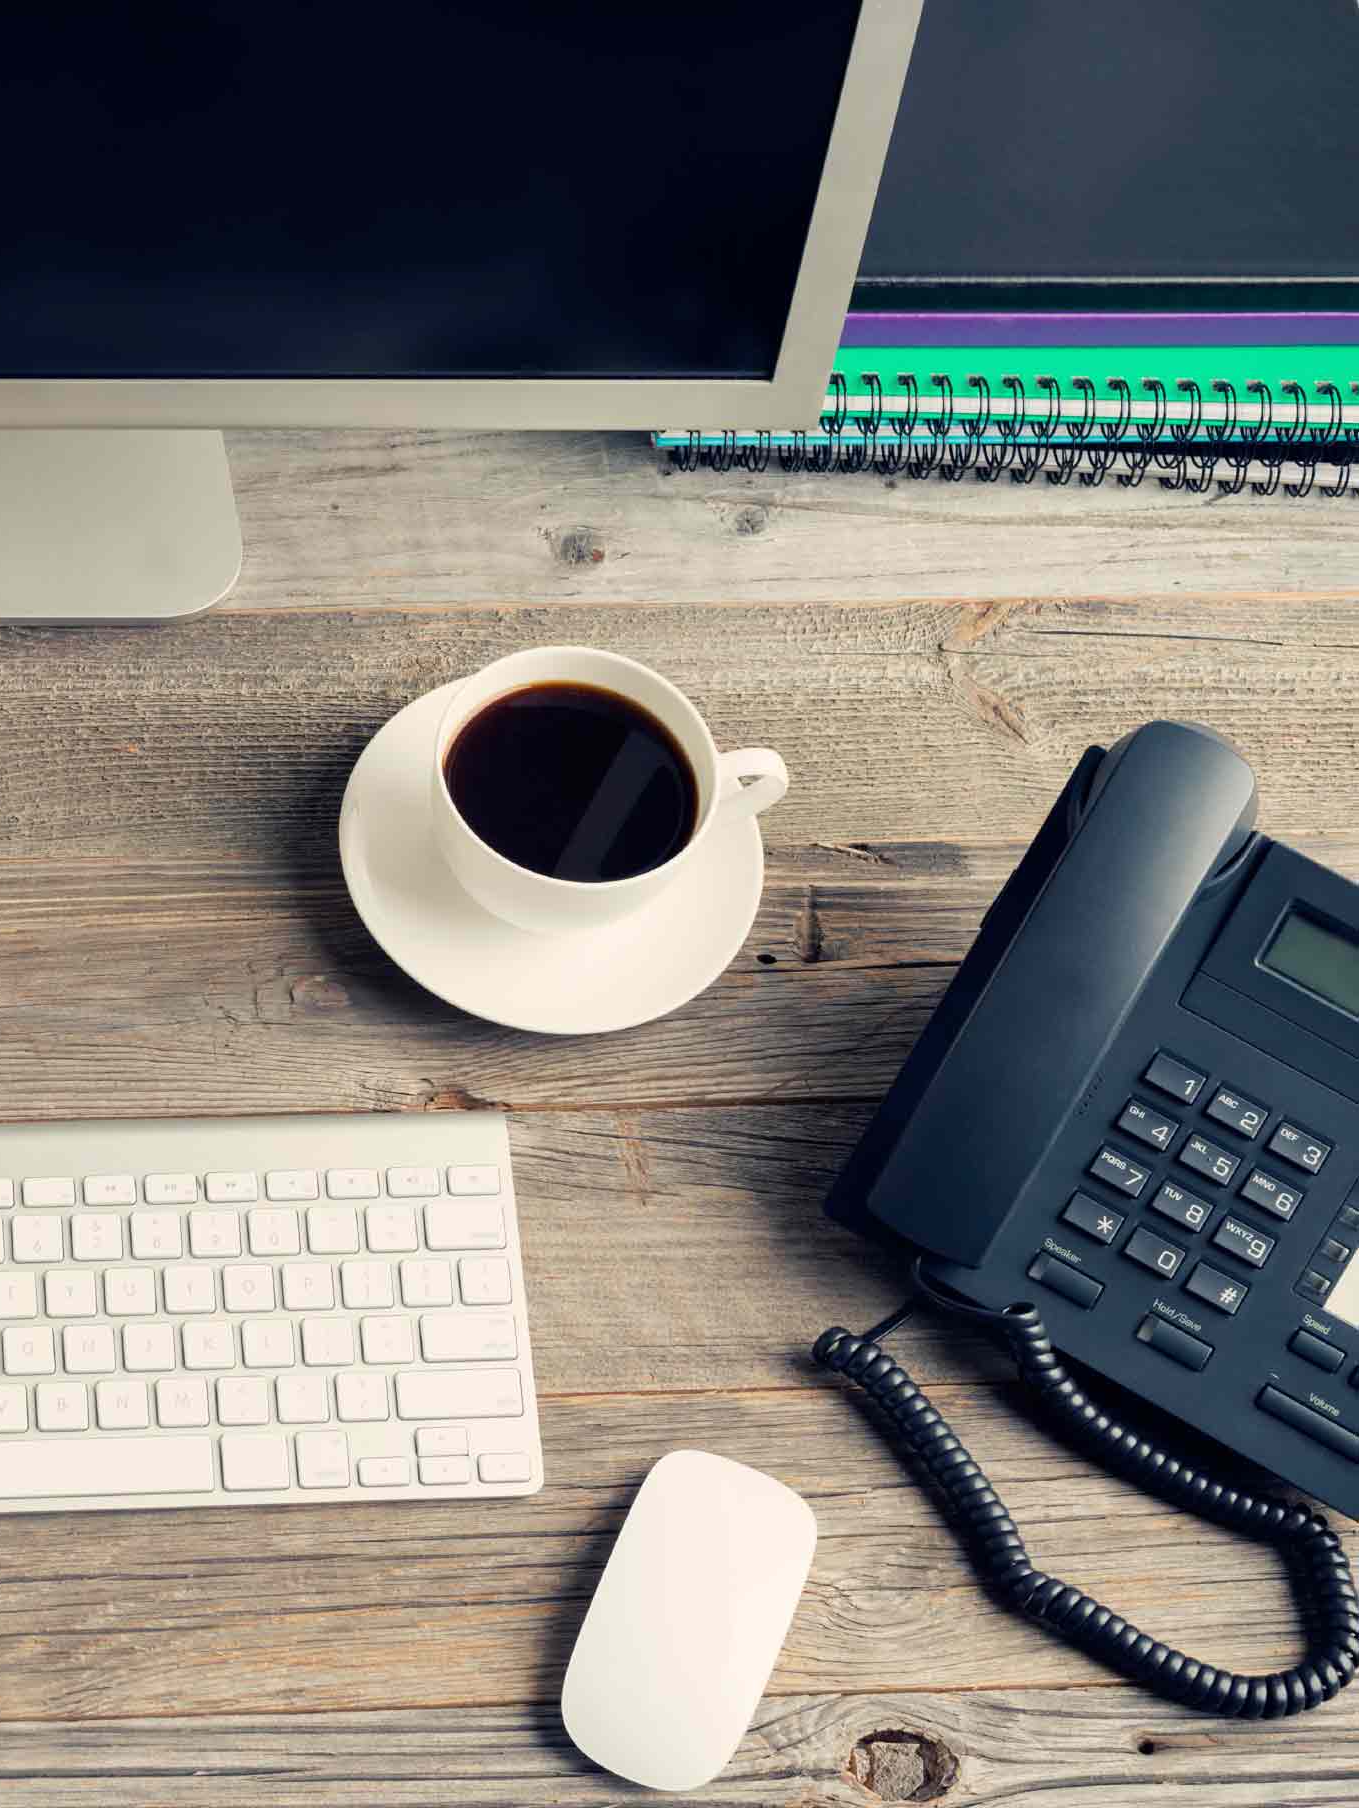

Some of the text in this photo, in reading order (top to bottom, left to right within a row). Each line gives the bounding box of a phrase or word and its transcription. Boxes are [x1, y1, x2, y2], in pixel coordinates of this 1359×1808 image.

[1184, 1079, 1196, 1096] 1
[1217, 1094, 1239, 1109] ABC
[1129, 1105, 1146, 1119] GHI
[1240, 1111, 1259, 1131] 2
[1151, 1125, 1169, 1142] 4
[1280, 1128, 1300, 1142] DEF
[1191, 1141, 1208, 1155] JKL
[1303, 1146, 1322, 1165] 3
[1101, 1151, 1127, 1170] PQRS
[1213, 1157, 1232, 1177] 5
[1125, 1168, 1144, 1185] 7
[1252, 1175, 1276, 1192] MNO
[1164, 1186, 1184, 1201] TUV
[1275, 1192, 1294, 1212] 6
[1185, 1204, 1204, 1224] 8
[1225, 1221, 1254, 1243] WXYZ
[1043, 1237, 1082, 1264] Speaker
[1247, 1239, 1267, 1259] 9
[1157, 1250, 1177, 1270] 0
[1152, 1298, 1202, 1331] Hold/Save
[1309, 1392, 1341, 1417] Volume
